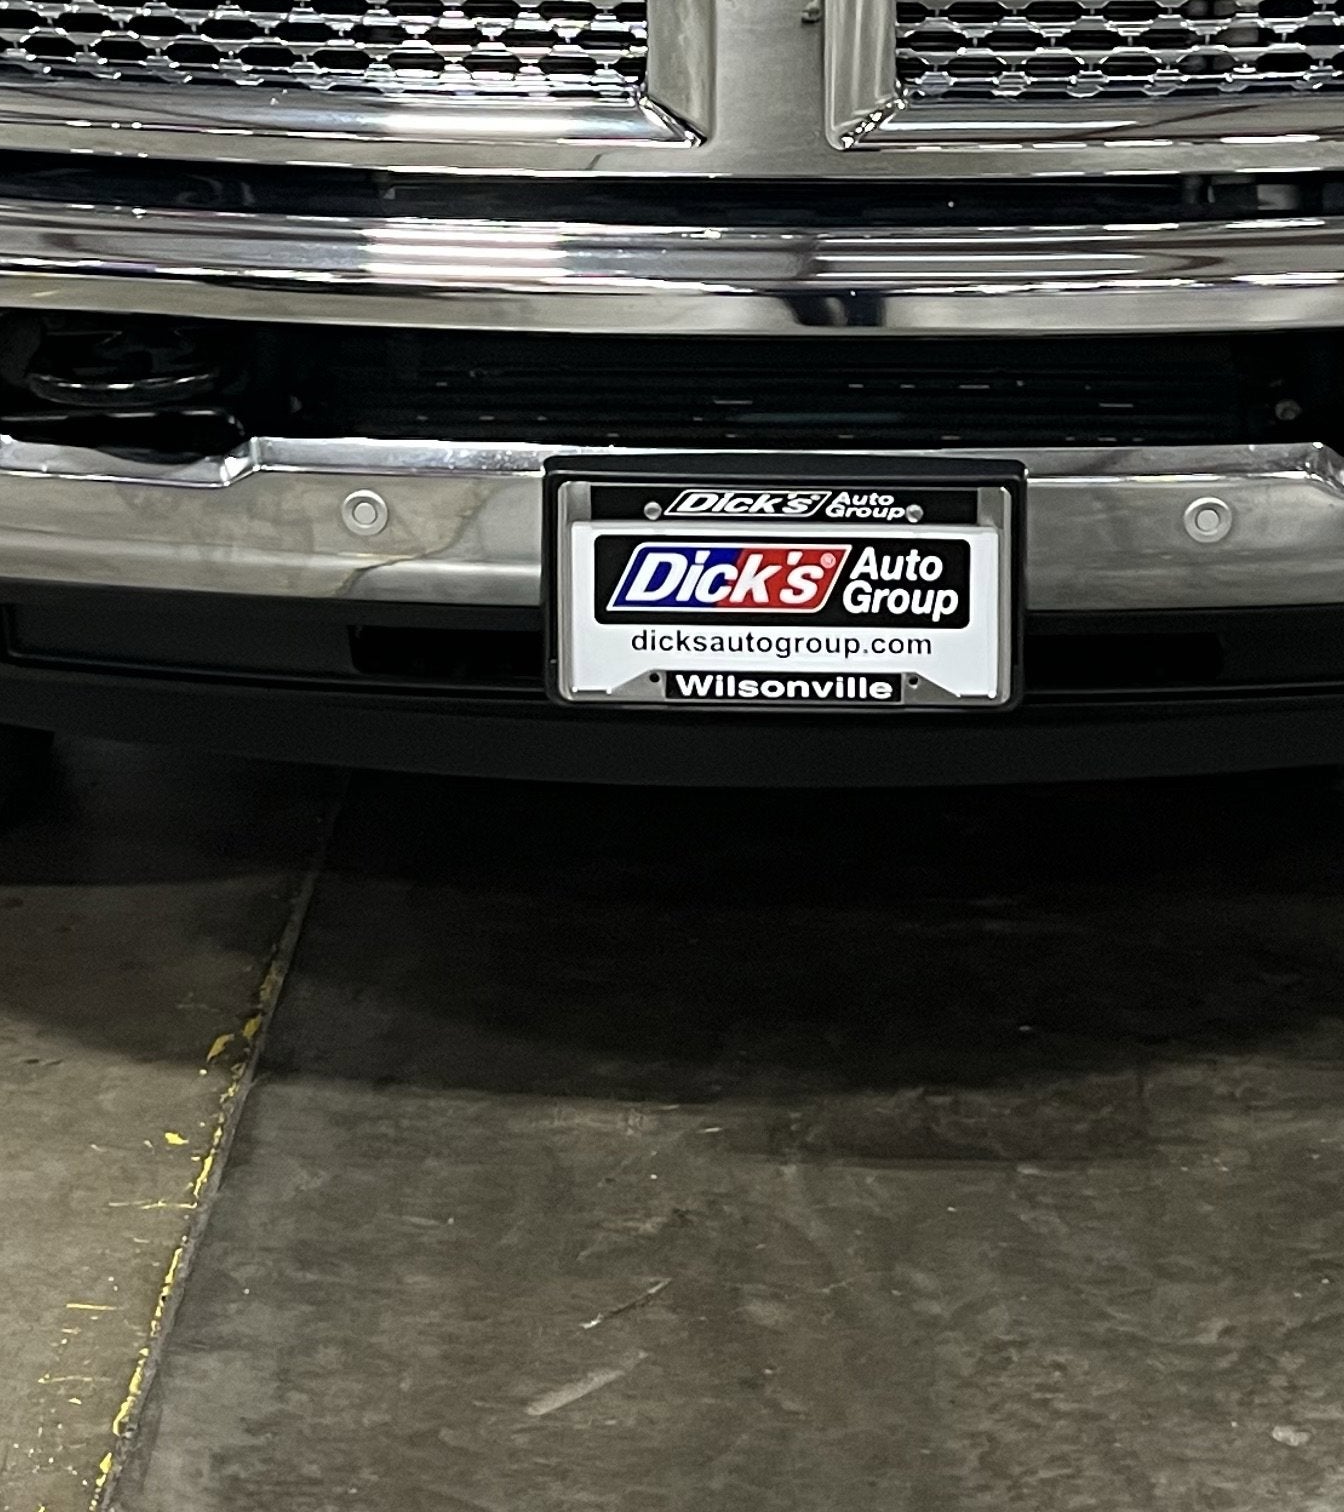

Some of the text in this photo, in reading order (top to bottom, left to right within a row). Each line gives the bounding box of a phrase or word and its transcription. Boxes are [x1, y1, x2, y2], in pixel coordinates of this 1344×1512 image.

[676, 491, 895, 514] Dick's Auto
[825, 505, 906, 521] Group
[625, 545, 944, 604] Dick's Auto
[842, 579, 959, 622] Group
[631, 630, 932, 659] dicksautogroup.com
[675, 673, 893, 700] Wilsonville
